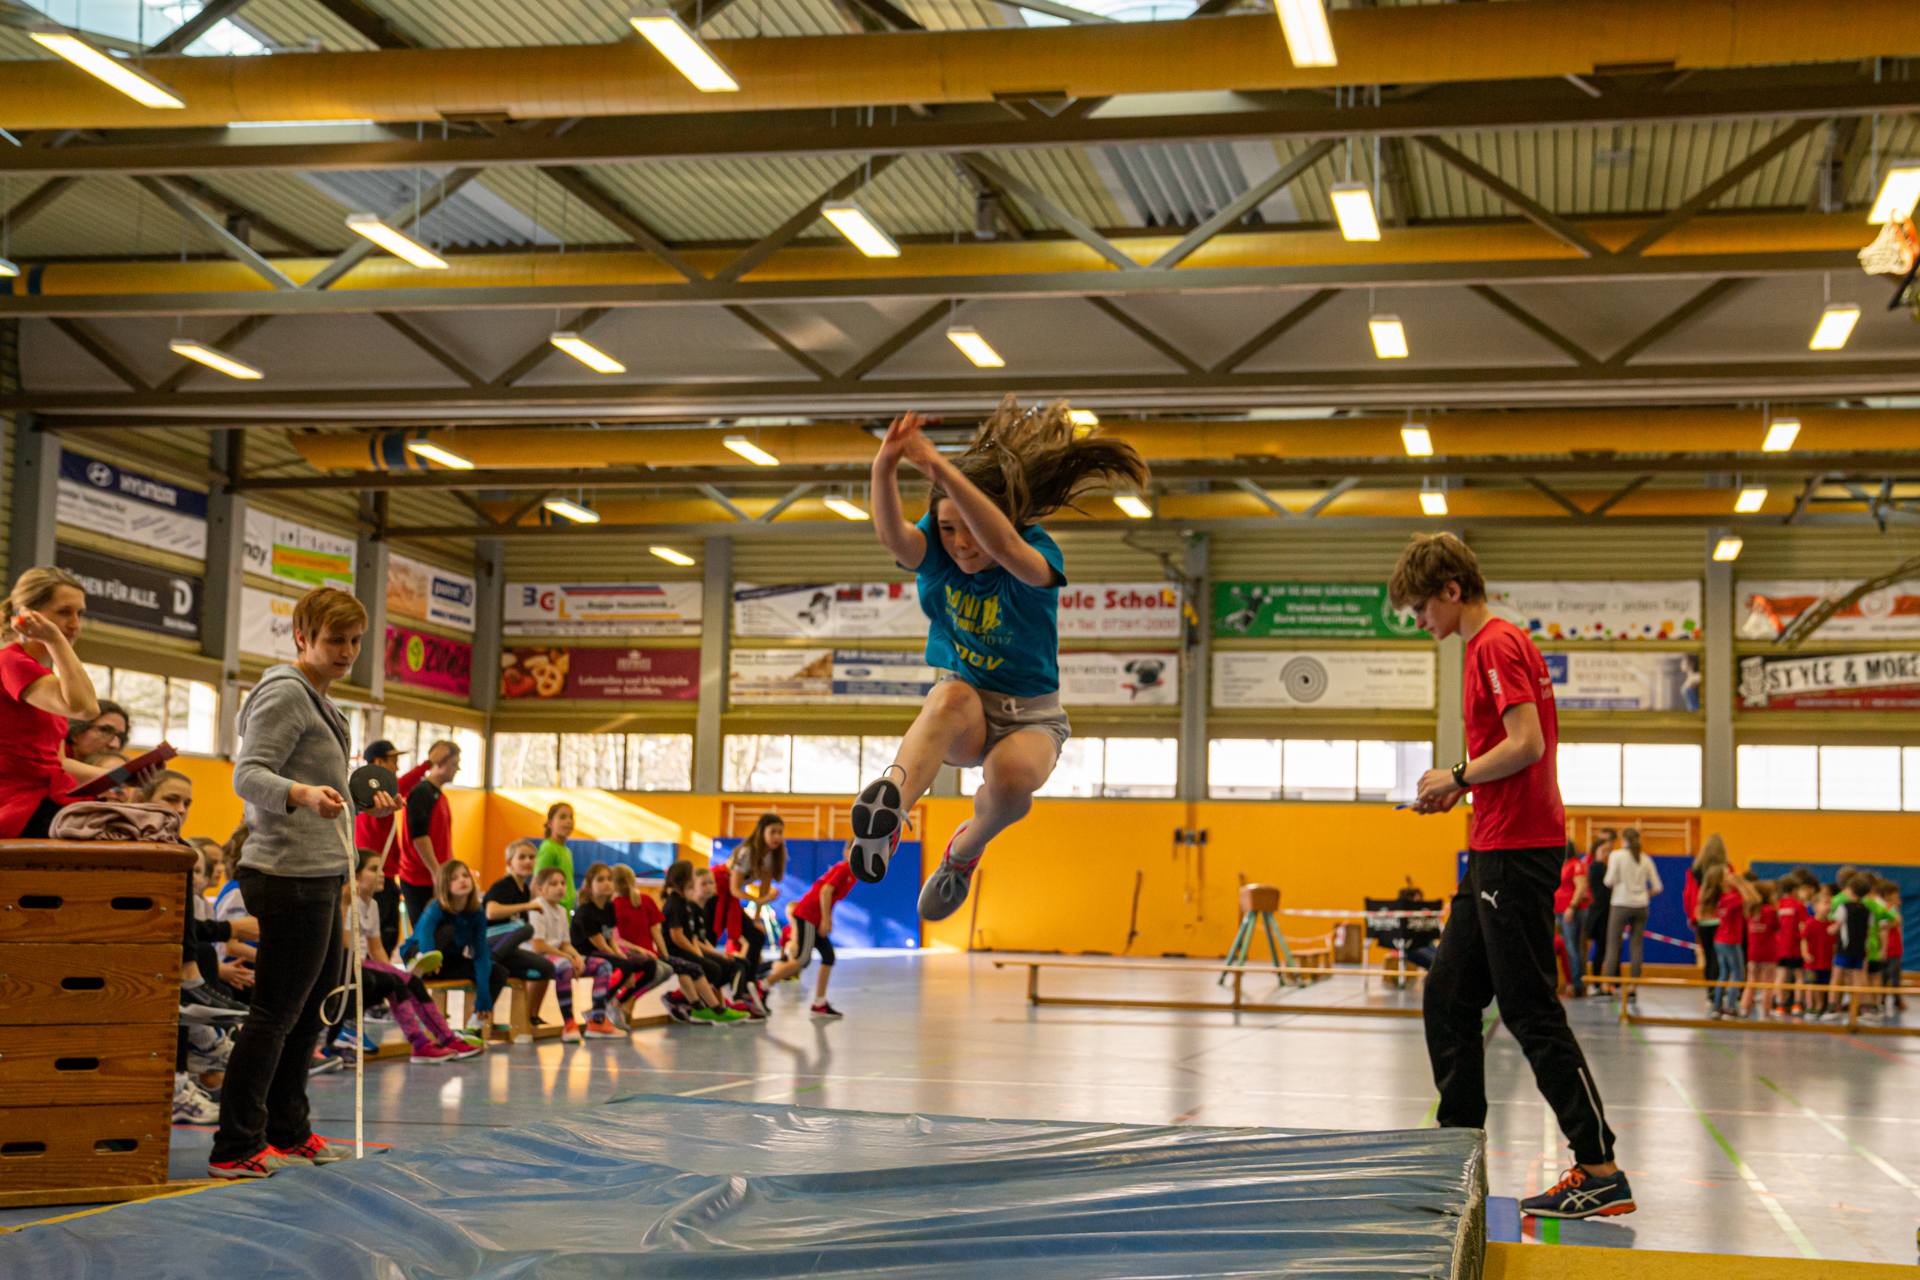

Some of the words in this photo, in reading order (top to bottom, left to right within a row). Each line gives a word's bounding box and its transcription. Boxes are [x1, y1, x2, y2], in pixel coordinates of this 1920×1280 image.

[1059, 590, 1096, 609] ule
[1768, 661, 1833, 690] STYLE
[1844, 659, 1858, 684] &
